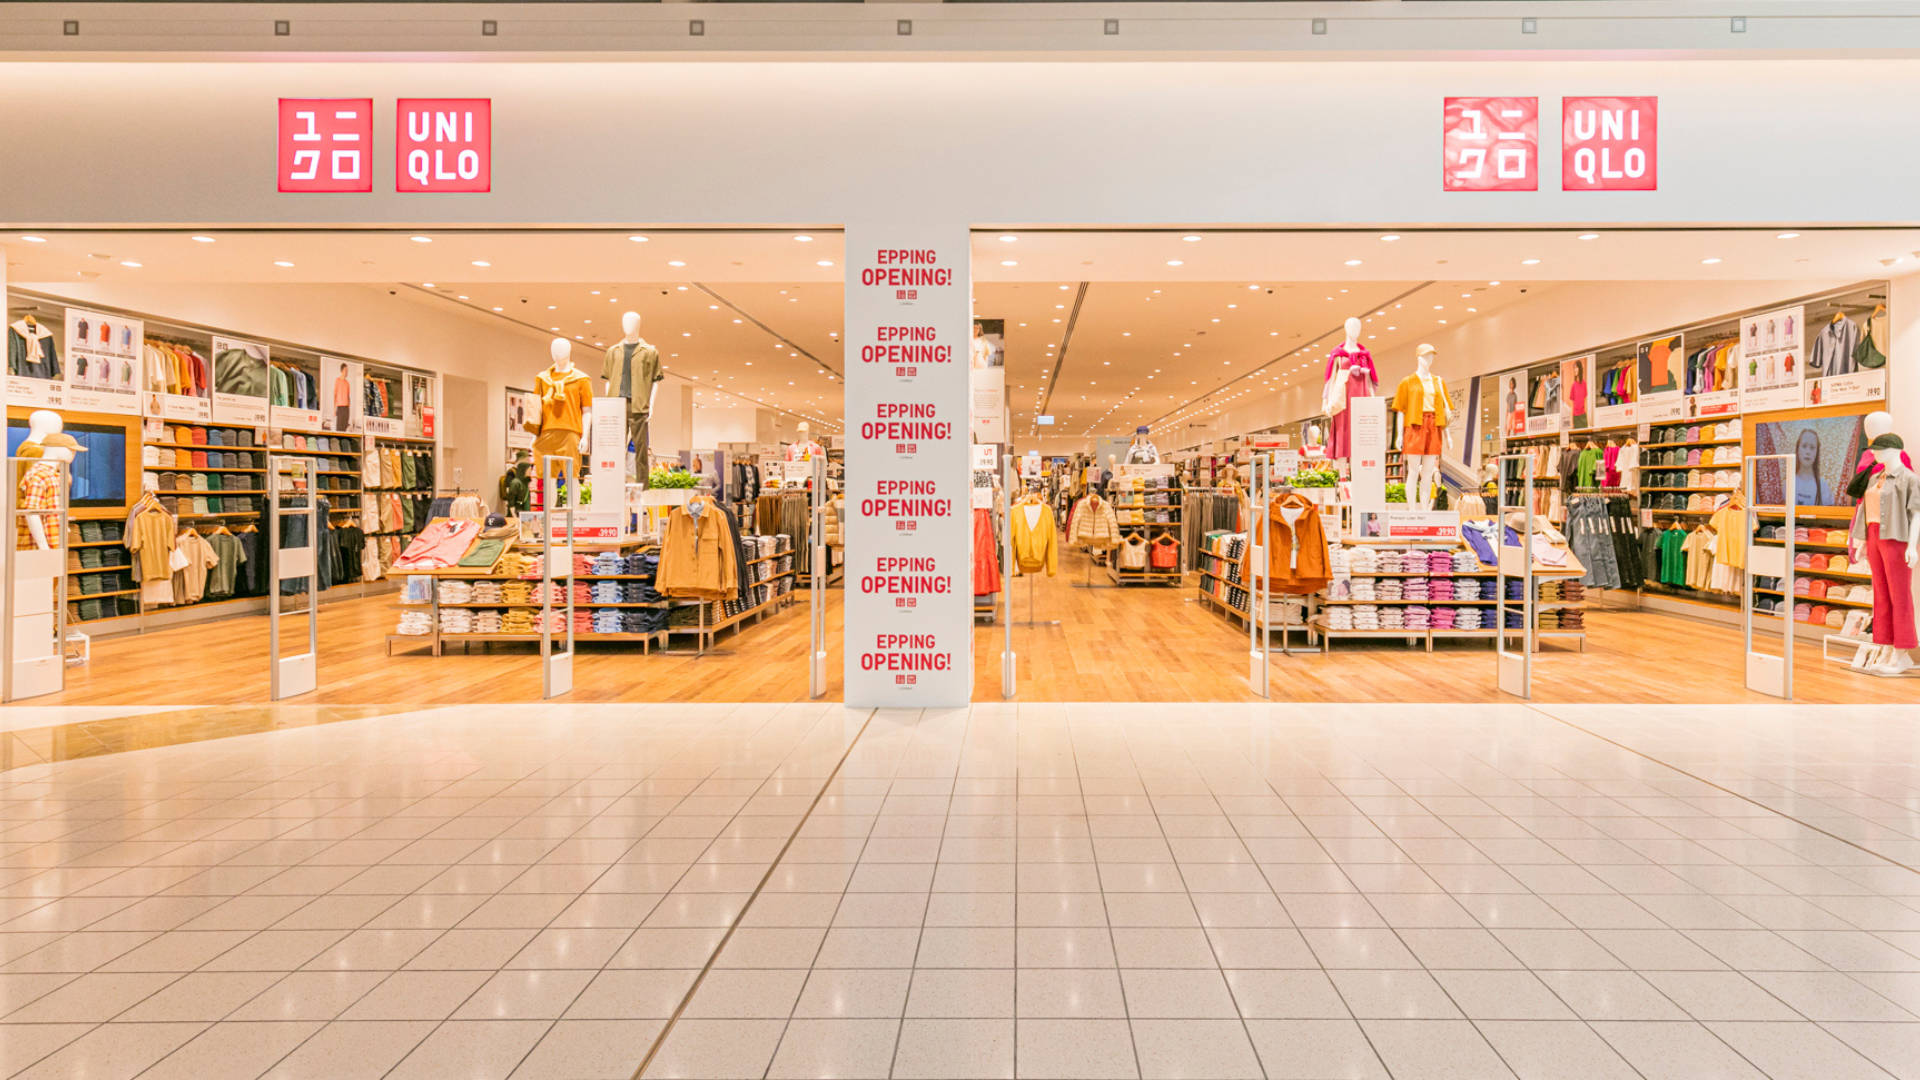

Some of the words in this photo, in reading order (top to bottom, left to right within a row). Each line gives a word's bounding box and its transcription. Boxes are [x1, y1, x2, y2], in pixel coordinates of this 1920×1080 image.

[293, 111, 360, 141] ユニ
[408, 111, 473, 142] UNI
[1574, 109, 1639, 140] UNI
[290, 150, 360, 179] クロ
[408, 149, 479, 186] QLO
[1574, 147, 1646, 184] QLO
[877, 249, 936, 264] EPPING
[861, 267, 952, 286] OPENING!
[877, 326, 936, 341] EPPING
[861, 344, 952, 363] OPENING!
[877, 403, 936, 418] EPPING
[861, 421, 952, 440] OPENING!
[877, 479, 936, 495] EPPING
[861, 498, 952, 517] OPENING!
[877, 556, 936, 572] EPPING
[861, 575, 952, 593] OPENING!
[877, 633, 936, 649] EPPING
[861, 652, 952, 670] OPENING!
